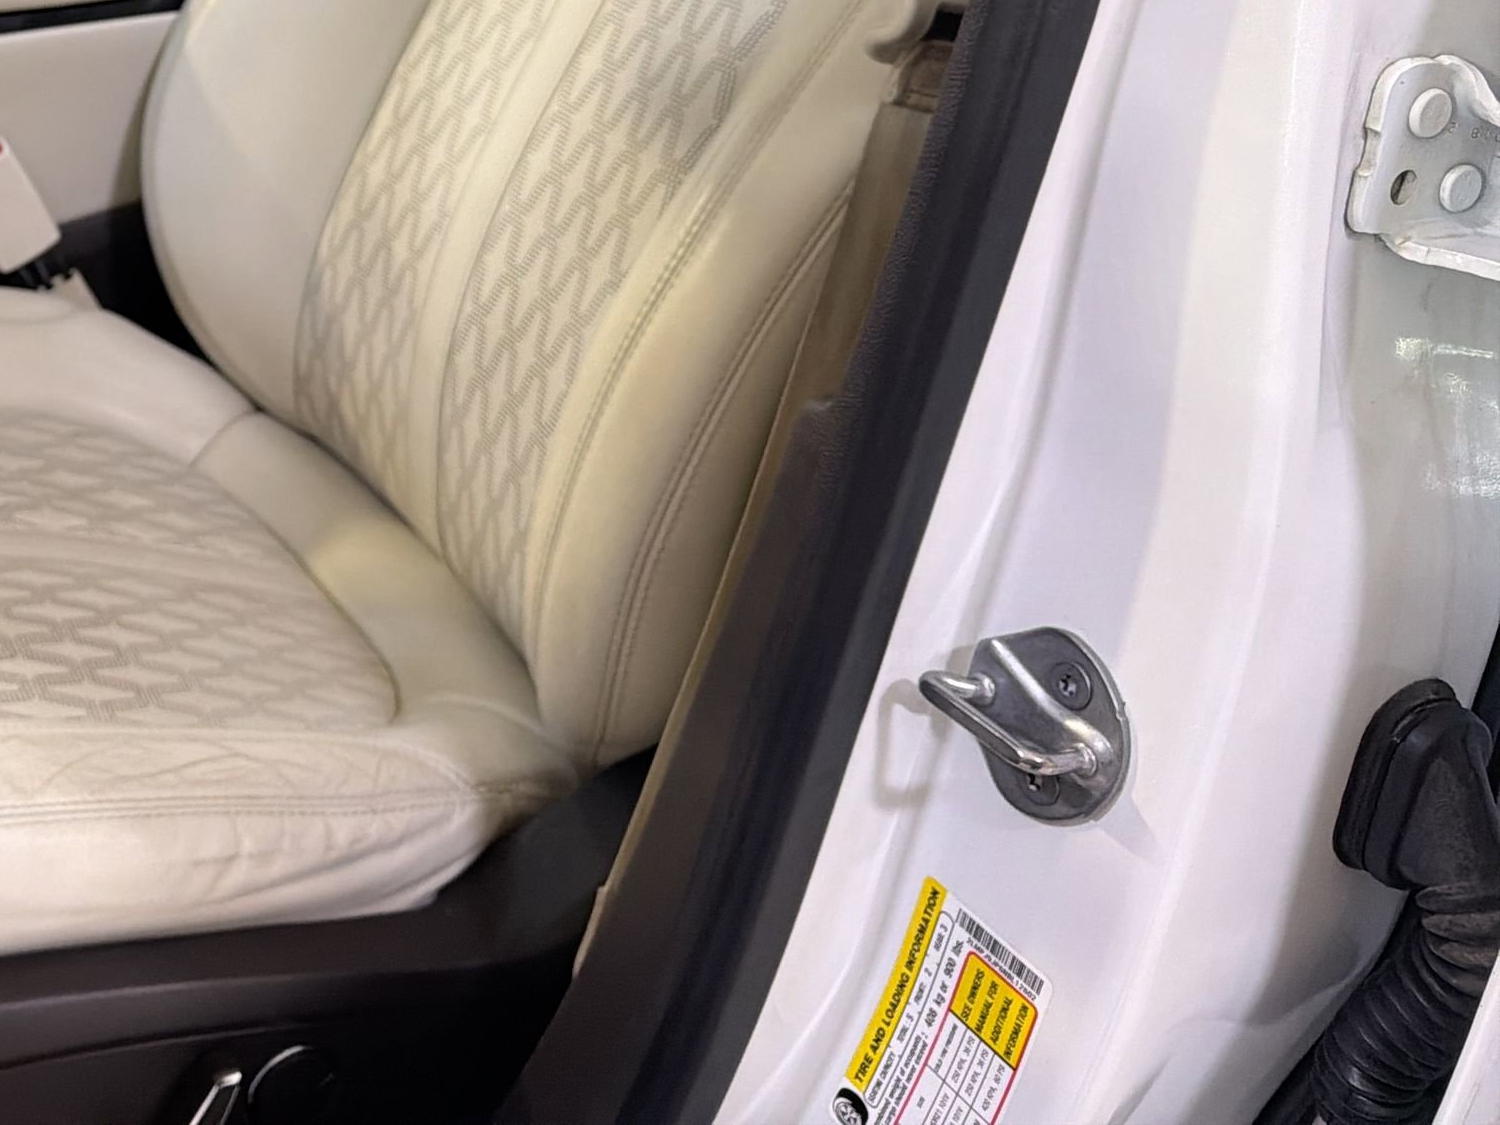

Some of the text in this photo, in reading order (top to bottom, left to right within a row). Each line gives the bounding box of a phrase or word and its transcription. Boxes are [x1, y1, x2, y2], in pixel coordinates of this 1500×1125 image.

[940, 924, 948, 932] 3
[854, 887, 940, 1083] TIRE AND LOADING INFORMATION
[924, 968, 932, 977] 2
[933, 993, 946, 1007] kg
[940, 981, 948, 993] or
[944, 957, 956, 978] 900
[960, 969, 985, 1022] SEE OWNERS
[975, 980, 999, 1033] MANUAL FOR
[990, 997, 1014, 1045] ADDITIONAL
[1003, 1003, 1030, 1061] INFORMATION
[889, 1075, 902, 1099] weight
[904, 1035, 922, 1068] occupants
[894, 1083, 908, 1107] should
[905, 1065, 916, 1084] never
